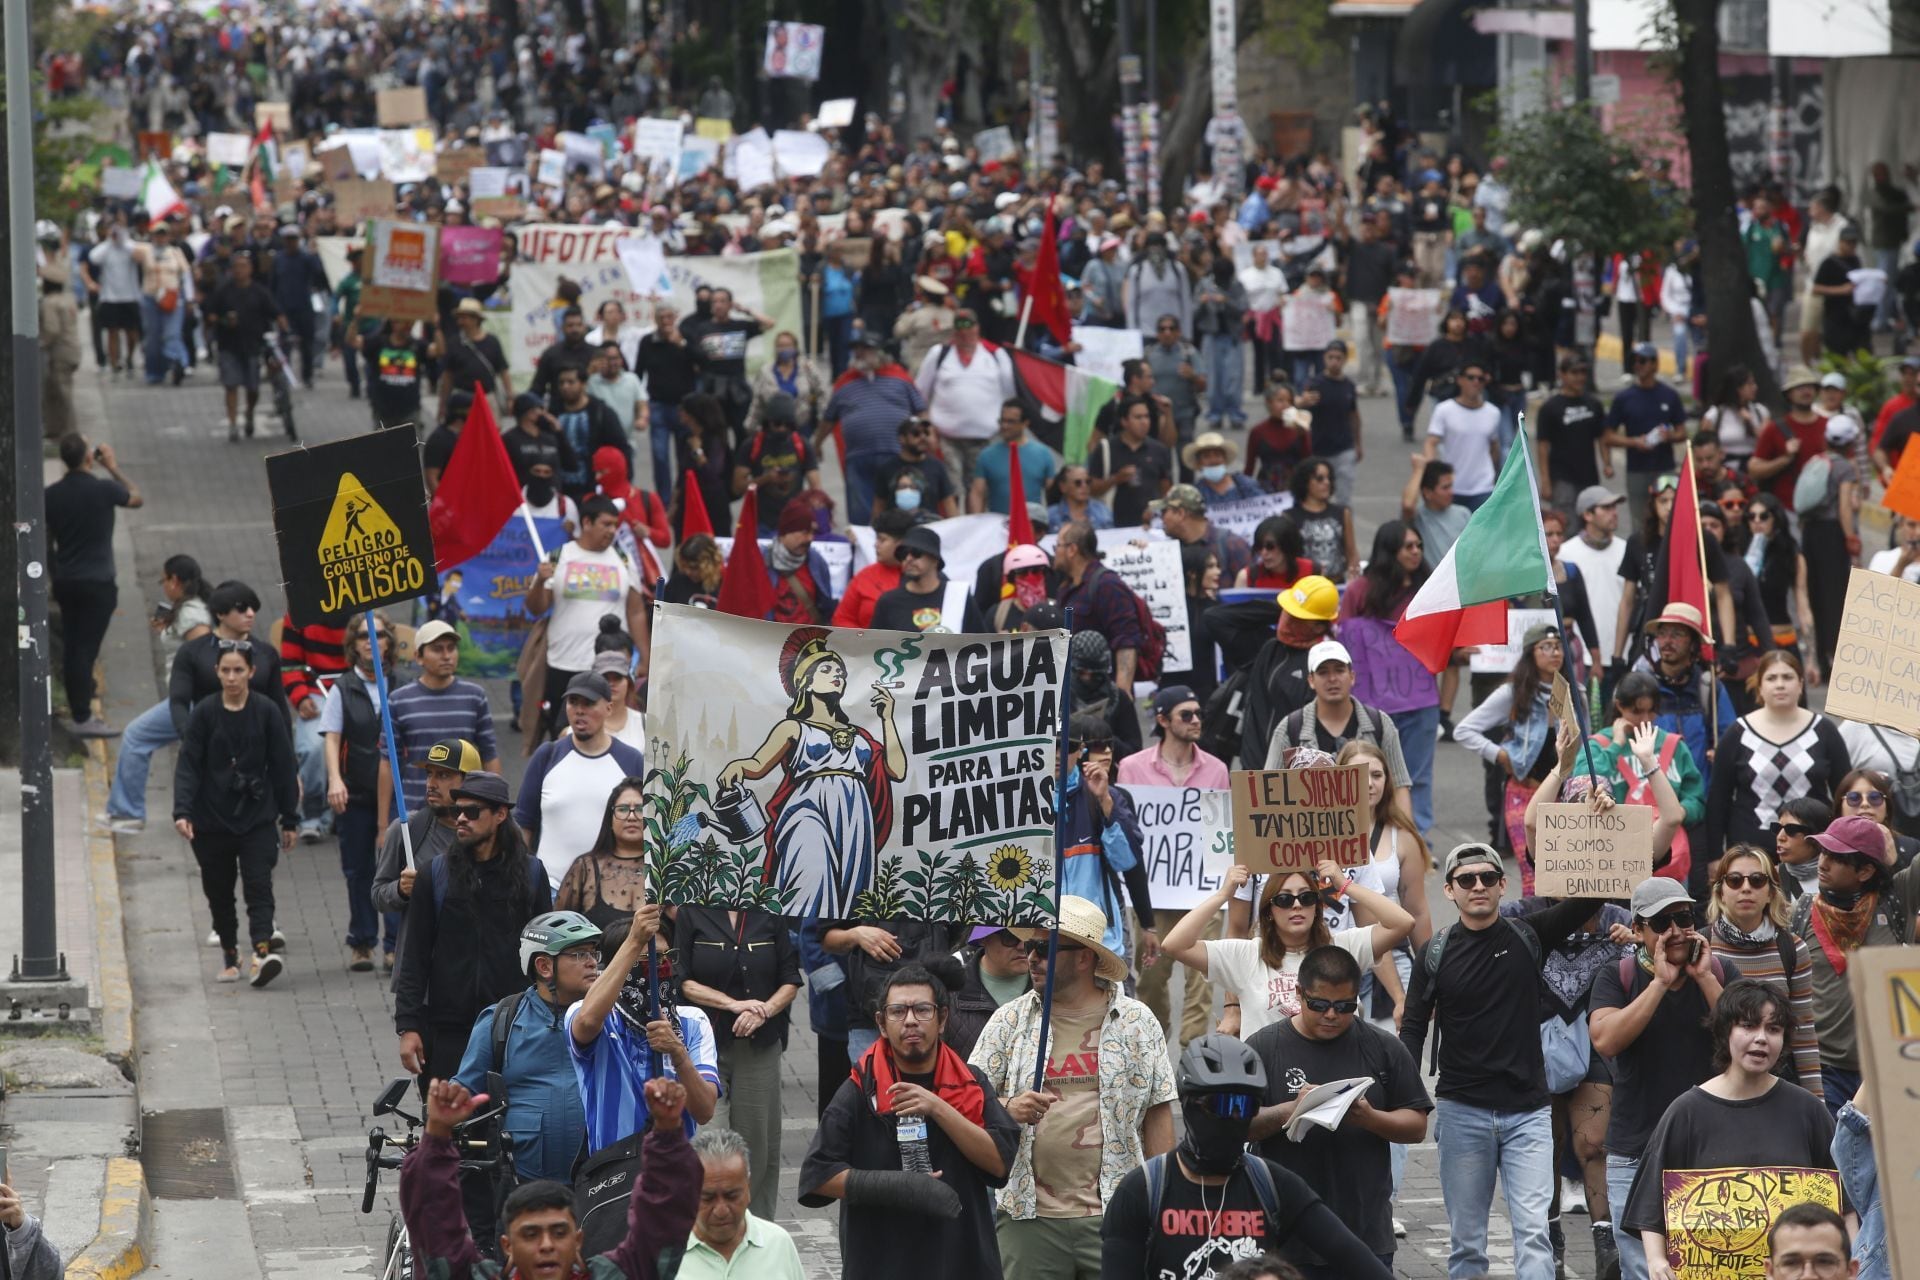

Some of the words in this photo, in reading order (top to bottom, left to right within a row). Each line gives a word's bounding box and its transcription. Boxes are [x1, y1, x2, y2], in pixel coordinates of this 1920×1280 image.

[322, 529, 395, 562] PELIGRO
[323, 550, 391, 580] GOBIERNO
[394, 545, 410, 560] DE
[319, 557, 424, 613] JALISCO
[489, 575, 535, 599] JALI
[1845, 612, 1884, 637] POR
[915, 636, 1058, 700] AGUA
[1839, 642, 1884, 670] CON
[1835, 672, 1920, 712] CONTAM
[912, 690, 1057, 755] LIMPIA
[928, 755, 994, 789] PARA
[1000, 748, 1045, 778] LAS
[1299, 767, 1360, 808] SILENCIO
[902, 775, 1056, 847] PLANTAS
[1545, 814, 1626, 832] NOSOTROS
[1566, 839, 1614, 853] SOMOS
[1545, 859, 1594, 872] DIGNOS
[1598, 859, 1617, 871] DE
[1622, 860, 1646, 873] ESTA
[1566, 877, 1632, 895] BANDERA
[1046, 1077, 1068, 1086] ATURAL
[1695, 1172, 1755, 1207] LOS
[1760, 1171, 1796, 1202] DE
[1688, 1204, 1768, 1234] ARRIBA
